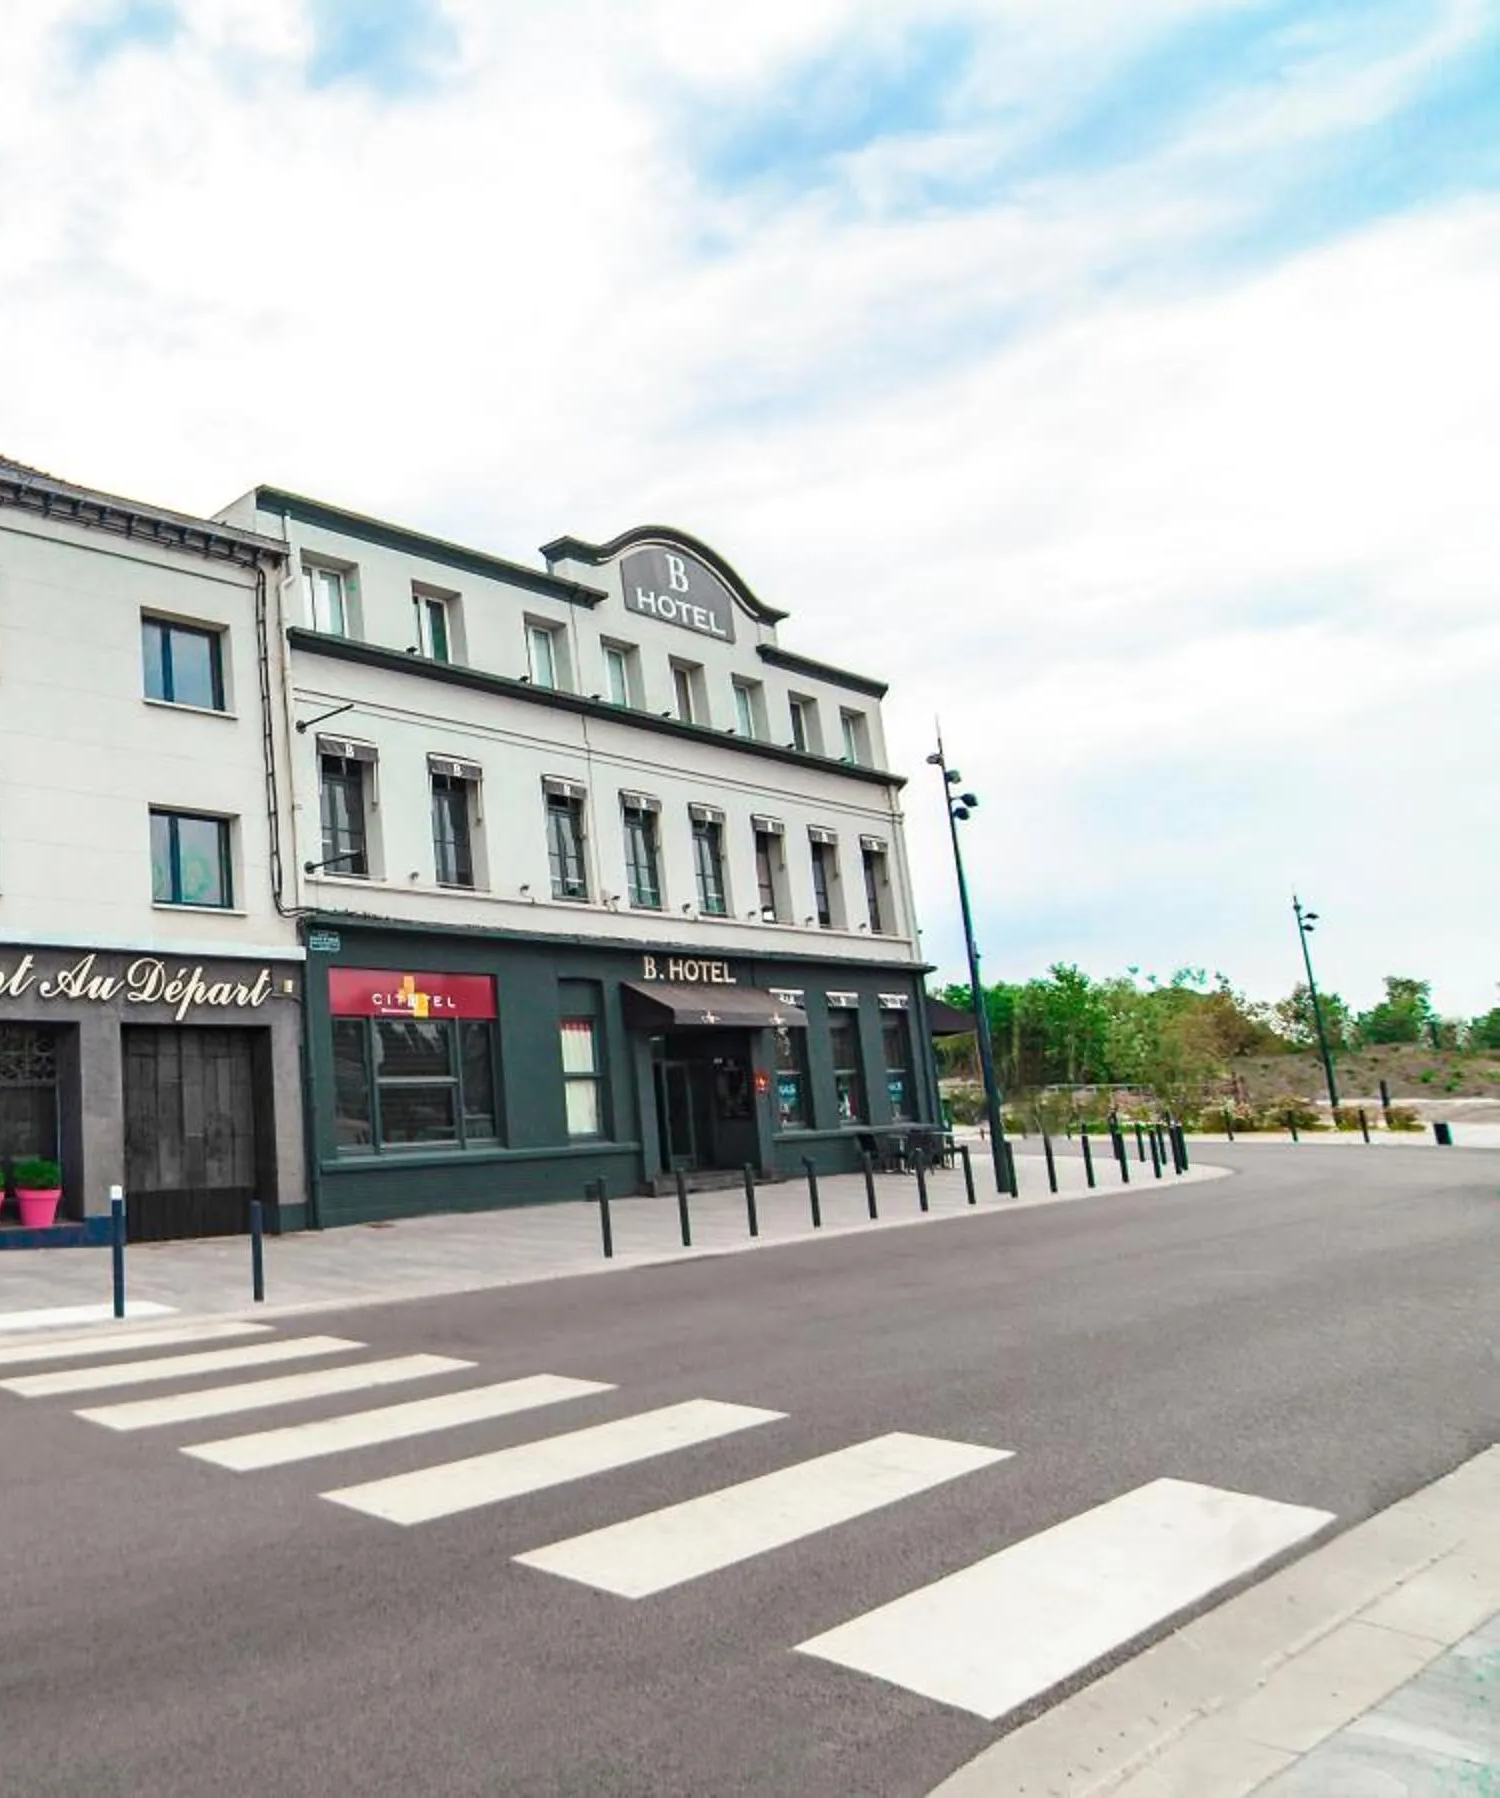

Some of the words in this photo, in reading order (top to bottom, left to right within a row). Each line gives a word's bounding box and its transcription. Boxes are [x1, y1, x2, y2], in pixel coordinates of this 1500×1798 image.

[665, 553, 689, 592] B
[636, 587, 727, 637] HOTEL
[41, 954, 126, 1000] Au
[126, 957, 272, 1020] Départ
[643, 956, 665, 980] B.
[669, 959, 737, 984] HOTEL
